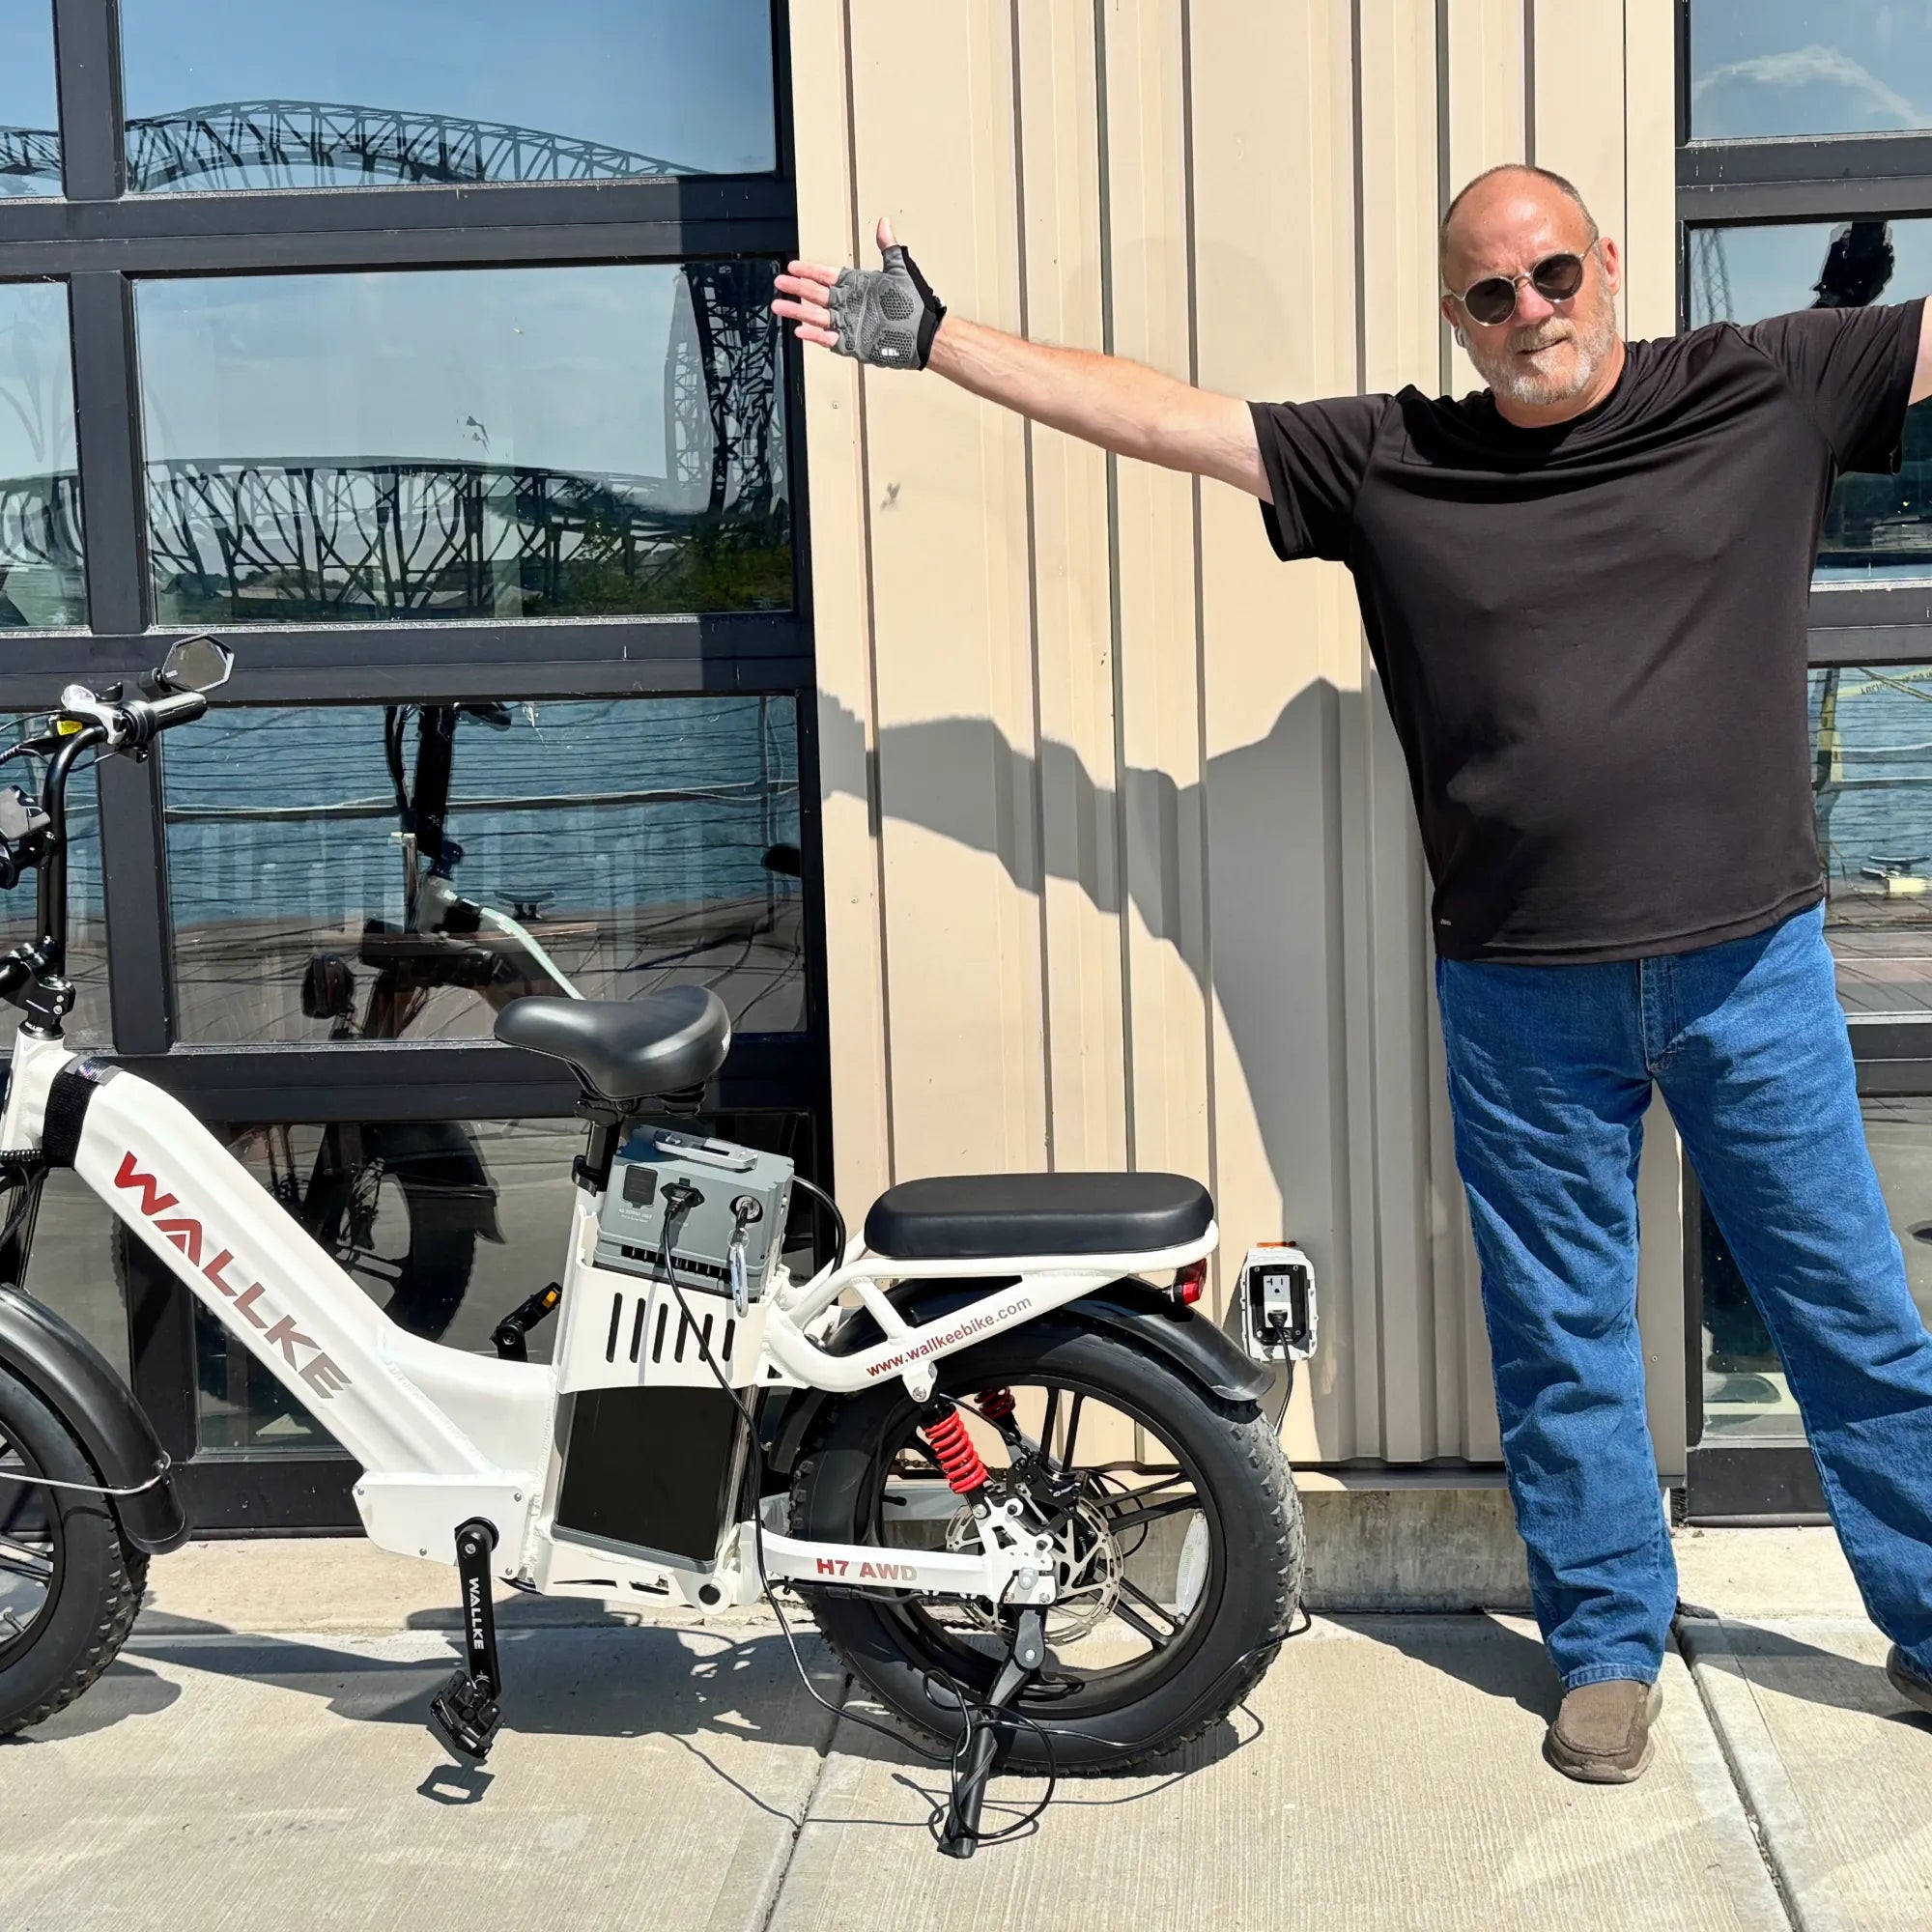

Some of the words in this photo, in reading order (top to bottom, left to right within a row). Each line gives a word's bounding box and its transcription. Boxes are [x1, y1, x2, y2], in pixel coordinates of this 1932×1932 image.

[114, 1151, 353, 1400] WALLKE
[866, 1296, 1033, 1378] www.wallkeebike.com
[816, 1557, 849, 1577] H7
[859, 1561, 918, 1581] AWD
[469, 1577, 485, 1650] WALLKE
